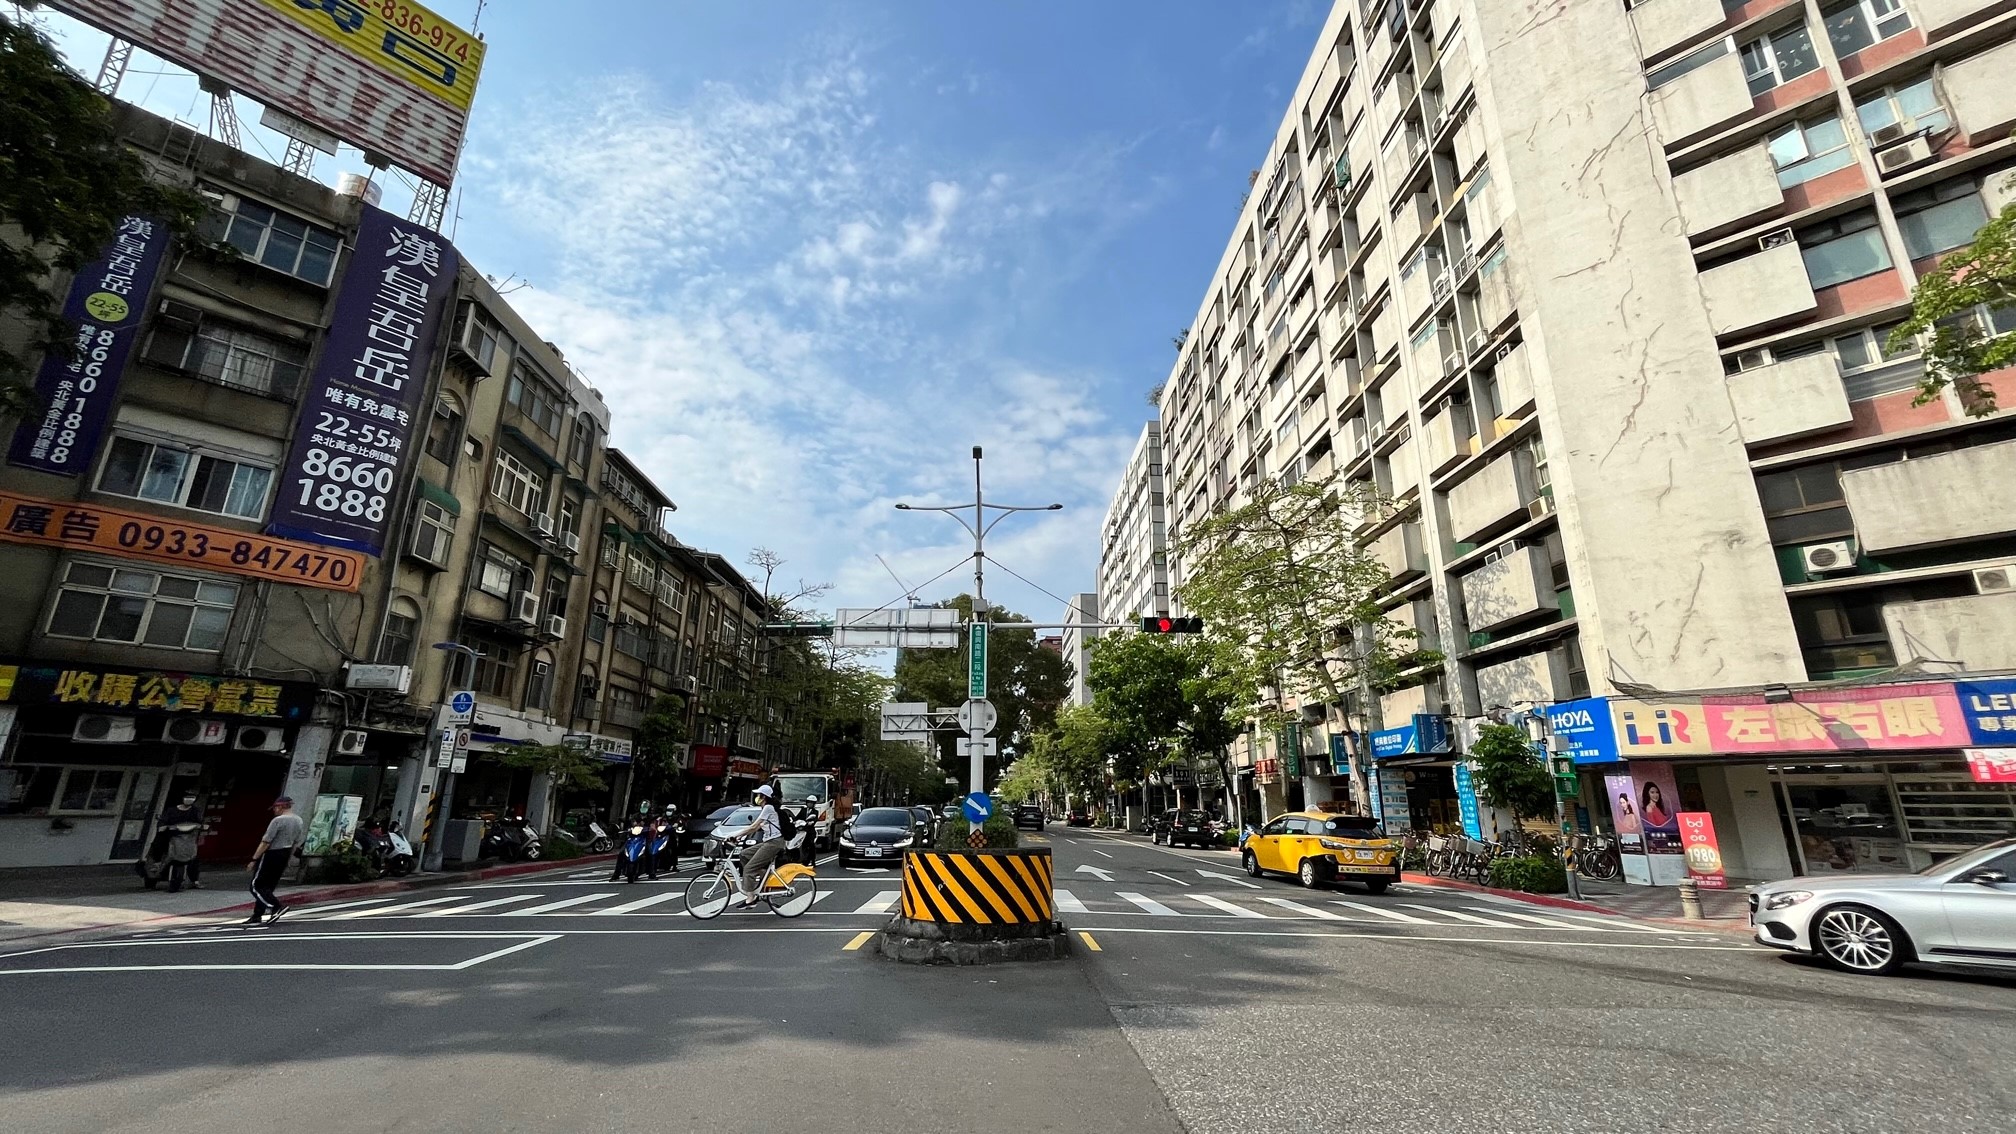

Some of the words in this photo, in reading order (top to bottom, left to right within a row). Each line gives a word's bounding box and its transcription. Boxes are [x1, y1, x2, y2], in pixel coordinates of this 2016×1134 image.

[89, 296, 127, 314] 22-55
[352, 225, 443, 391] 漢皇吾岳
[79, 330, 115, 393] 8660
[324, 386, 409, 427] 唯有免震宅
[50, 397, 86, 464] 1888
[302, 448, 394, 495] 8660
[297, 478, 387, 523] 1888
[4, 504, 100, 543] 廣告
[118, 521, 348, 582] 0933-847470
[1551, 710, 1594, 729] HOYA
[1722, 697, 1945, 744] 左眼右眼
[1687, 847, 1716, 863] 1980
